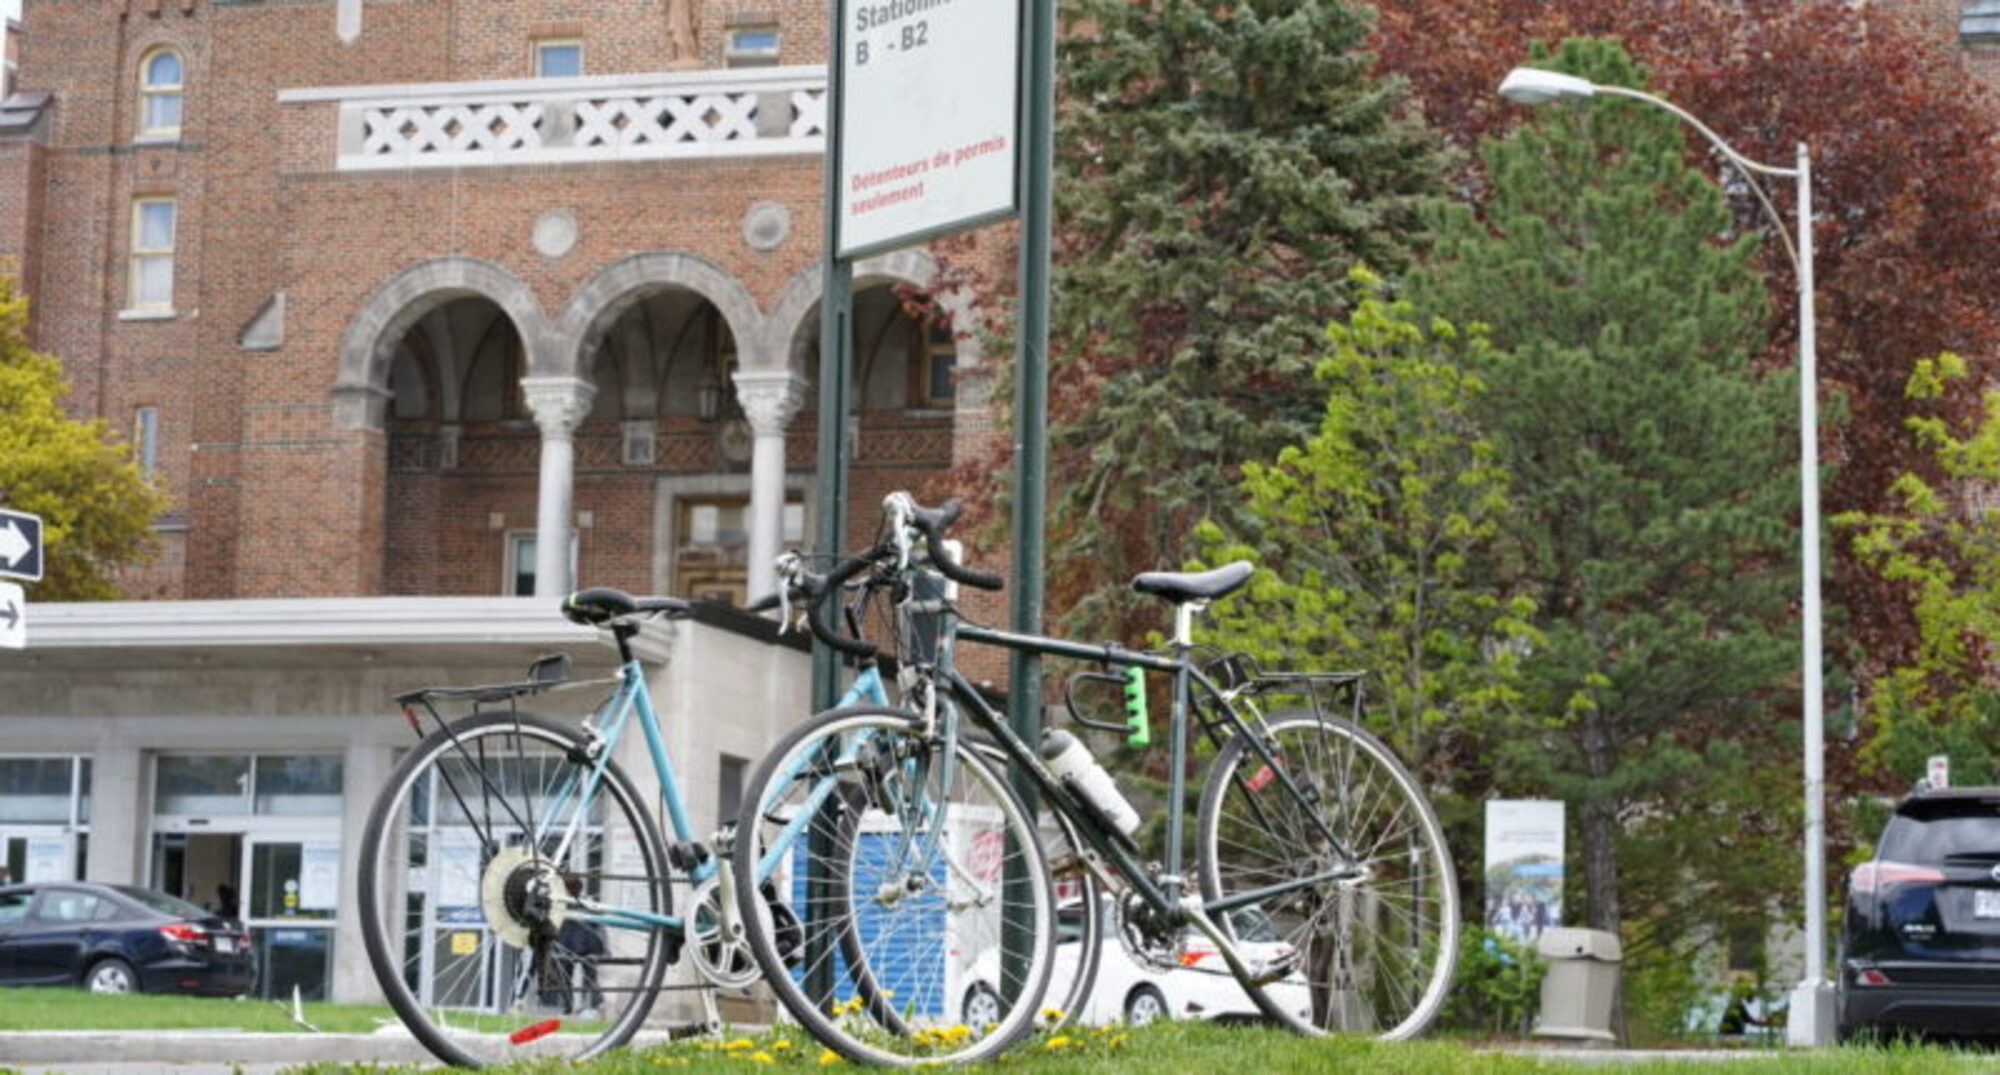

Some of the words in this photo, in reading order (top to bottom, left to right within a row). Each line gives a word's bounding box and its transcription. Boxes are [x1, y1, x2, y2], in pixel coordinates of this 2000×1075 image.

[856, 40, 869, 66] B
[902, 20, 928, 51] B2
[933, 150, 951, 168] de
[954, 133, 1005, 167] permis
[851, 181, 924, 214] seulement
